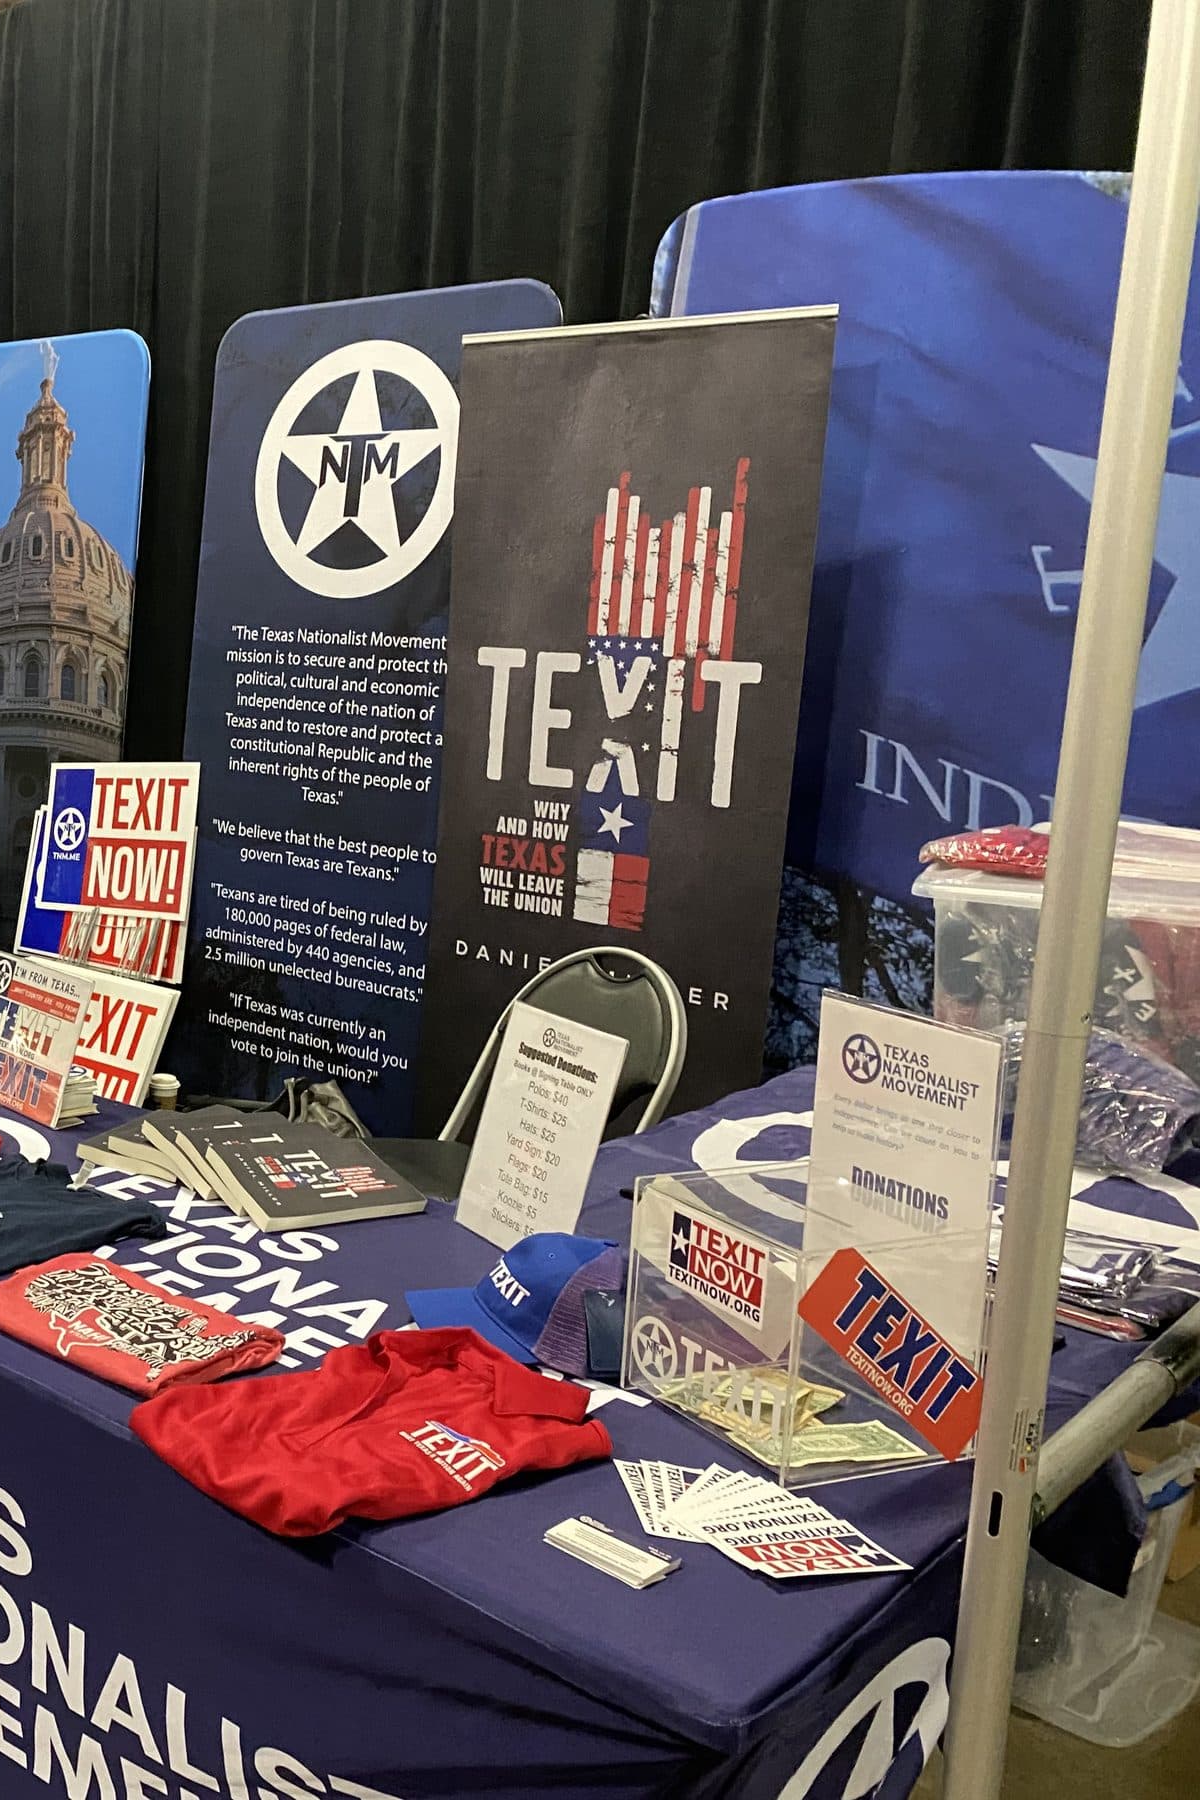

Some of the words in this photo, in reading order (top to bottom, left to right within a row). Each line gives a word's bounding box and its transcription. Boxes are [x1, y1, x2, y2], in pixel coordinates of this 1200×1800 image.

[232, 625, 259, 641] "The
[261, 627, 294, 642] Texas
[298, 628, 367, 646] Nationalist
[370, 631, 447, 650] Movement
[227, 649, 271, 664] mission
[275, 651, 284, 664] is
[288, 651, 300, 665] to
[304, 654, 345, 667] secure
[349, 655, 374, 669] and
[378, 657, 429, 674] protect
[433, 658, 448, 674] th
[236, 671, 287, 688] political,
[290, 674, 338, 690] cultural
[342, 678, 367, 692] and
[370, 681, 440, 698] economic
[237, 692, 326, 712] independence
[329, 700, 343, 713] of
[346, 700, 367, 716] the
[371, 704, 415, 720] nation
[419, 706, 435, 721] of
[225, 713, 257, 729] Texas
[260, 716, 283, 731] and
[287, 719, 299, 733] to
[303, 722, 348, 737] restore
[351, 725, 376, 739] and
[380, 728, 431, 745] protect
[435, 734, 443, 746] a
[477, 646, 763, 809] TEXIT
[230, 736, 314, 757] constitutional
[318, 743, 375, 763] Republic
[378, 750, 405, 766] and
[409, 752, 432, 768] the
[229, 757, 280, 776] inherent
[283, 764, 318, 781] rights
[322, 767, 336, 781] of
[339, 768, 360, 784] the
[363, 773, 411, 792] people
[415, 777, 431, 792] of
[95, 778, 189, 832] TEXIT
[301, 786, 343, 805] Texas."
[534, 800, 570, 821] WHY
[212, 819, 235, 835] "We
[238, 823, 282, 842] believe
[285, 830, 310, 846] that
[314, 833, 335, 849] the
[339, 836, 367, 854] best
[370, 842, 418, 863] people
[422, 848, 437, 863] to
[496, 816, 527, 836] AND
[532, 819, 569, 842] HOW
[240, 848, 283, 865] govern
[286, 852, 319, 870] Texas
[323, 859, 343, 873] are
[347, 860, 399, 882] Texans."
[481, 834, 566, 876] TEXAS
[87, 845, 179, 905] NOW!
[480, 866, 514, 889] WILL
[519, 874, 564, 897] LEAVE
[211, 882, 255, 903] "Texans
[258, 893, 277, 905] are
[280, 894, 309, 912] tired
[312, 901, 326, 915] of
[329, 905, 367, 925] being
[370, 912, 405, 929] ruled
[410, 915, 428, 936] by
[483, 888, 509, 908] THE
[514, 894, 562, 917] UNION
[225, 907, 270, 928] 180,000
[274, 917, 311, 938] pages
[315, 923, 329, 938] of
[331, 925, 376, 947] federal
[380, 934, 406, 955] law,
[205, 926, 283, 952] administered
[287, 938, 303, 958] by
[306, 944, 329, 961] 440
[333, 951, 394, 976] agencies,
[398, 964, 426, 980] and
[15, 967, 27, 979] I'M
[29, 972, 49, 985] FROM
[205, 946, 221, 962] 2.5
[225, 950, 265, 971] million
[269, 959, 331, 984] unelected
[336, 971, 423, 1003] bureaucrats."
[230, 992, 243, 1008] "If
[244, 995, 276, 1016] Texas
[280, 1007, 304, 1022] was
[307, 1012, 365, 1039] currently
[369, 1027, 386, 1041] an
[208, 1009, 286, 1041] independent
[289, 1031, 333, 1054] nation,
[337, 1041, 378, 1063] would
[382, 1051, 408, 1070] you
[884, 1043, 930, 1068] TEXAS
[231, 1038, 257, 1055] vote
[260, 1044, 272, 1058] to
[275, 1047, 299, 1066] join
[303, 1053, 324, 1071] the
[327, 1058, 378, 1084] union?"
[528, 1081, 551, 1099] Polos:
[553, 1092, 568, 1106] $40
[881, 1075, 967, 1111] MOVEMENT
[882, 1060, 979, 1098] NATIONALIST
[520, 1098, 550, 1121] T-Shirts:
[551, 1115, 568, 1128] $25
[519, 1119, 540, 1135] Hats:
[541, 1128, 557, 1143] $25
[506, 1132, 523, 1148] Yard
[523, 1142, 544, 1159] Sign:
[544, 1151, 561, 1166] $20
[507, 1154, 530, 1173] Flags:
[532, 1166, 547, 1182] $20
[497, 1168, 513, 1184] Tote
[514, 1175, 531, 1194] Bag:
[532, 1187, 548, 1204] $15
[852, 1165, 949, 1220] DONATIONS
[491, 1208, 522, 1233] Stickers:
[497, 1189, 525, 1211] Koozie:
[526, 1205, 538, 1219] $5
[691, 1220, 765, 1275] TEXIT
[693, 1249, 758, 1298] NOW
[668, 1266, 761, 1322] TEXITNOW.ORG
[835, 1266, 978, 1424] TEXIT
[845, 1346, 914, 1417] TEXITNOW.ORG
[411, 1420, 499, 1480] TEXIT
[702, 1511, 832, 1534] TEXITNOW.ORG
[725, 1524, 855, 1545] TEXITNOW.ORG
[758, 1539, 837, 1560] NOW
[766, 1556, 873, 1574] TEXIT
